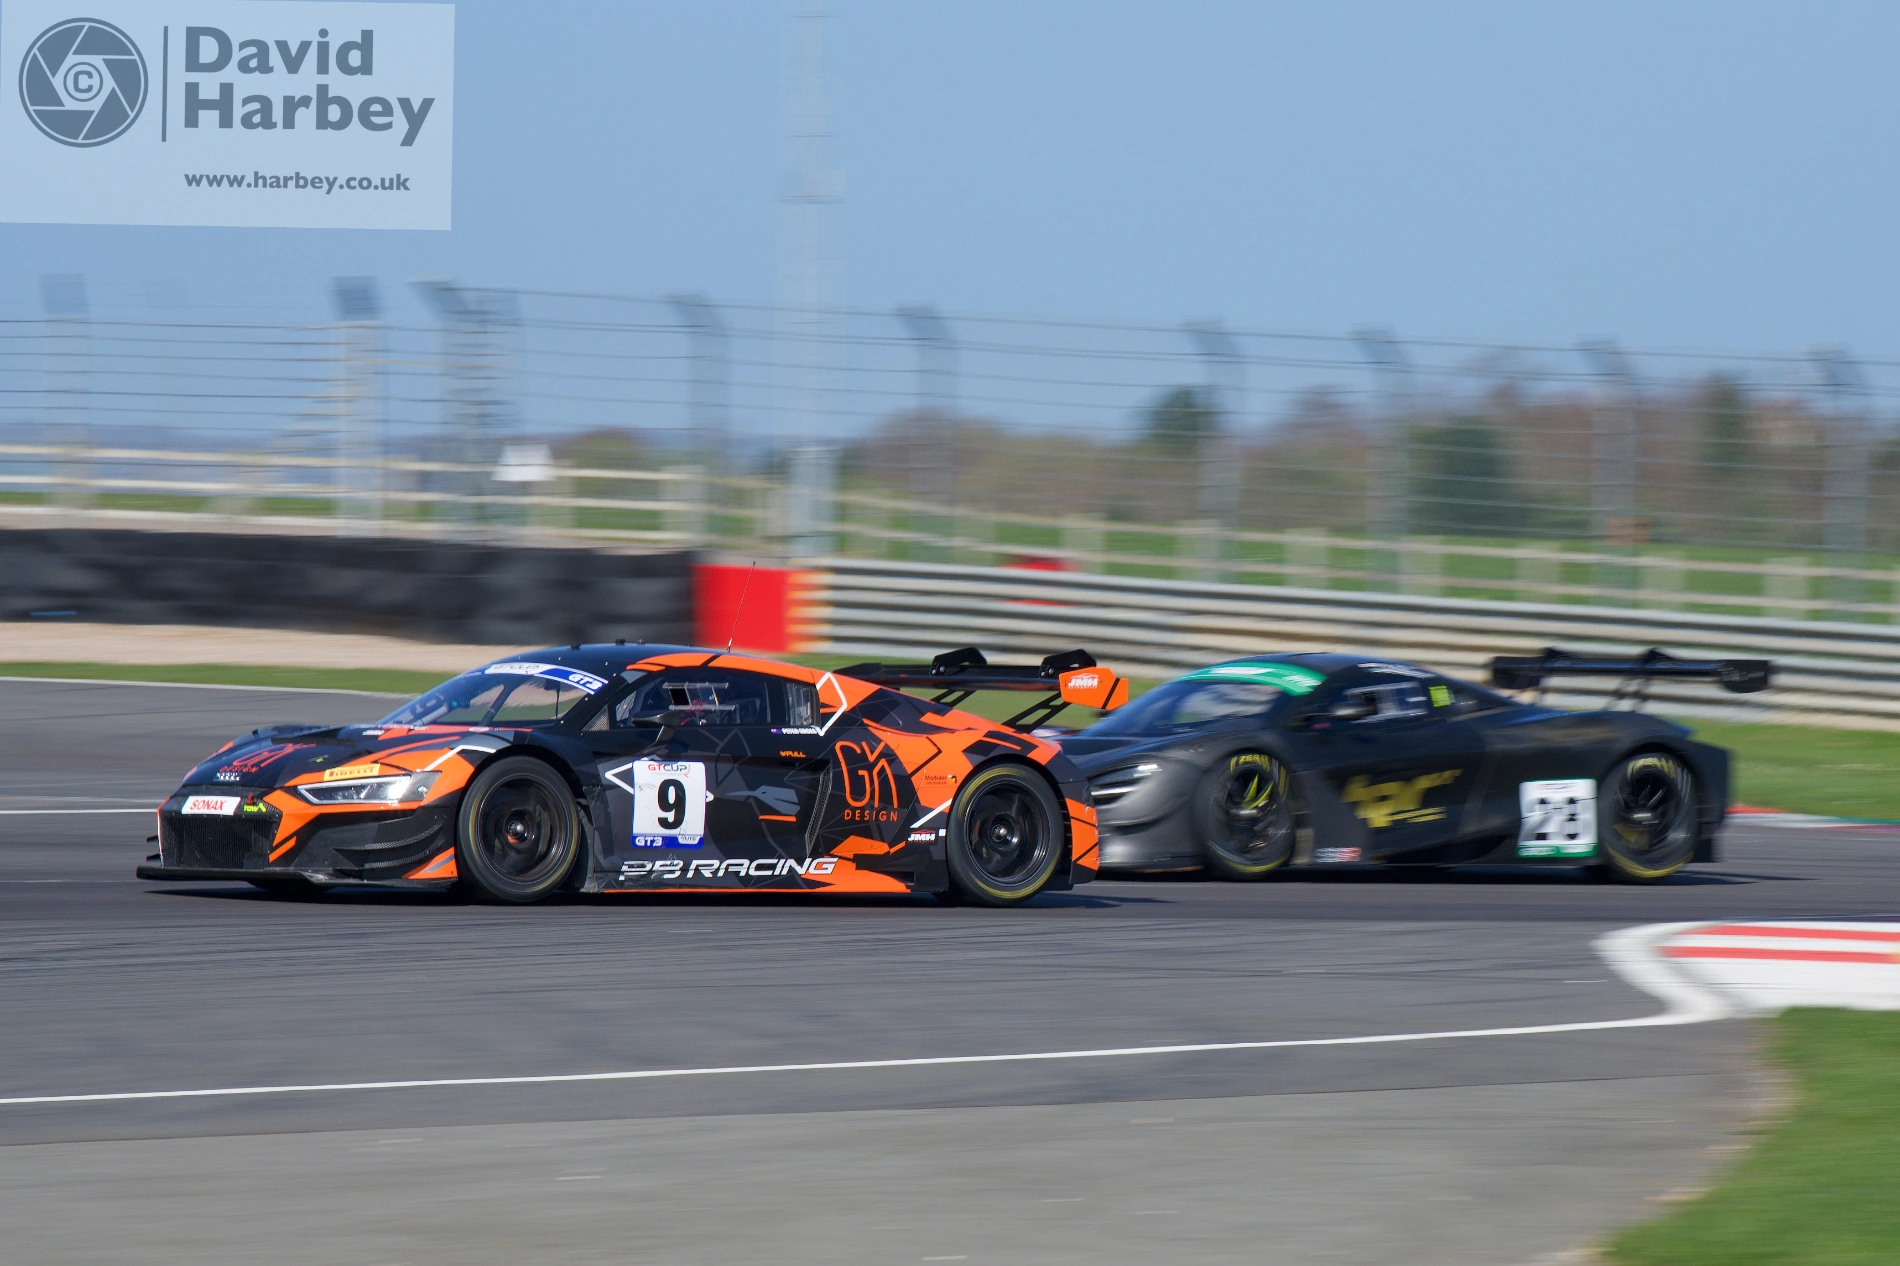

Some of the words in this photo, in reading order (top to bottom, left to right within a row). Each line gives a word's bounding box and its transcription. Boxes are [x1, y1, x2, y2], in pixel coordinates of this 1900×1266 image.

[568, 673, 603, 690] GT3
[1068, 678, 1099, 687] JMH
[190, 799, 226, 811] SONAX
[243, 804, 259, 812] TOW
[657, 778, 687, 830] 9
[844, 809, 899, 822] DESIGN
[635, 836, 663, 847] GT3
[908, 833, 936, 841] JMH
[687, 856, 839, 879] RACING
